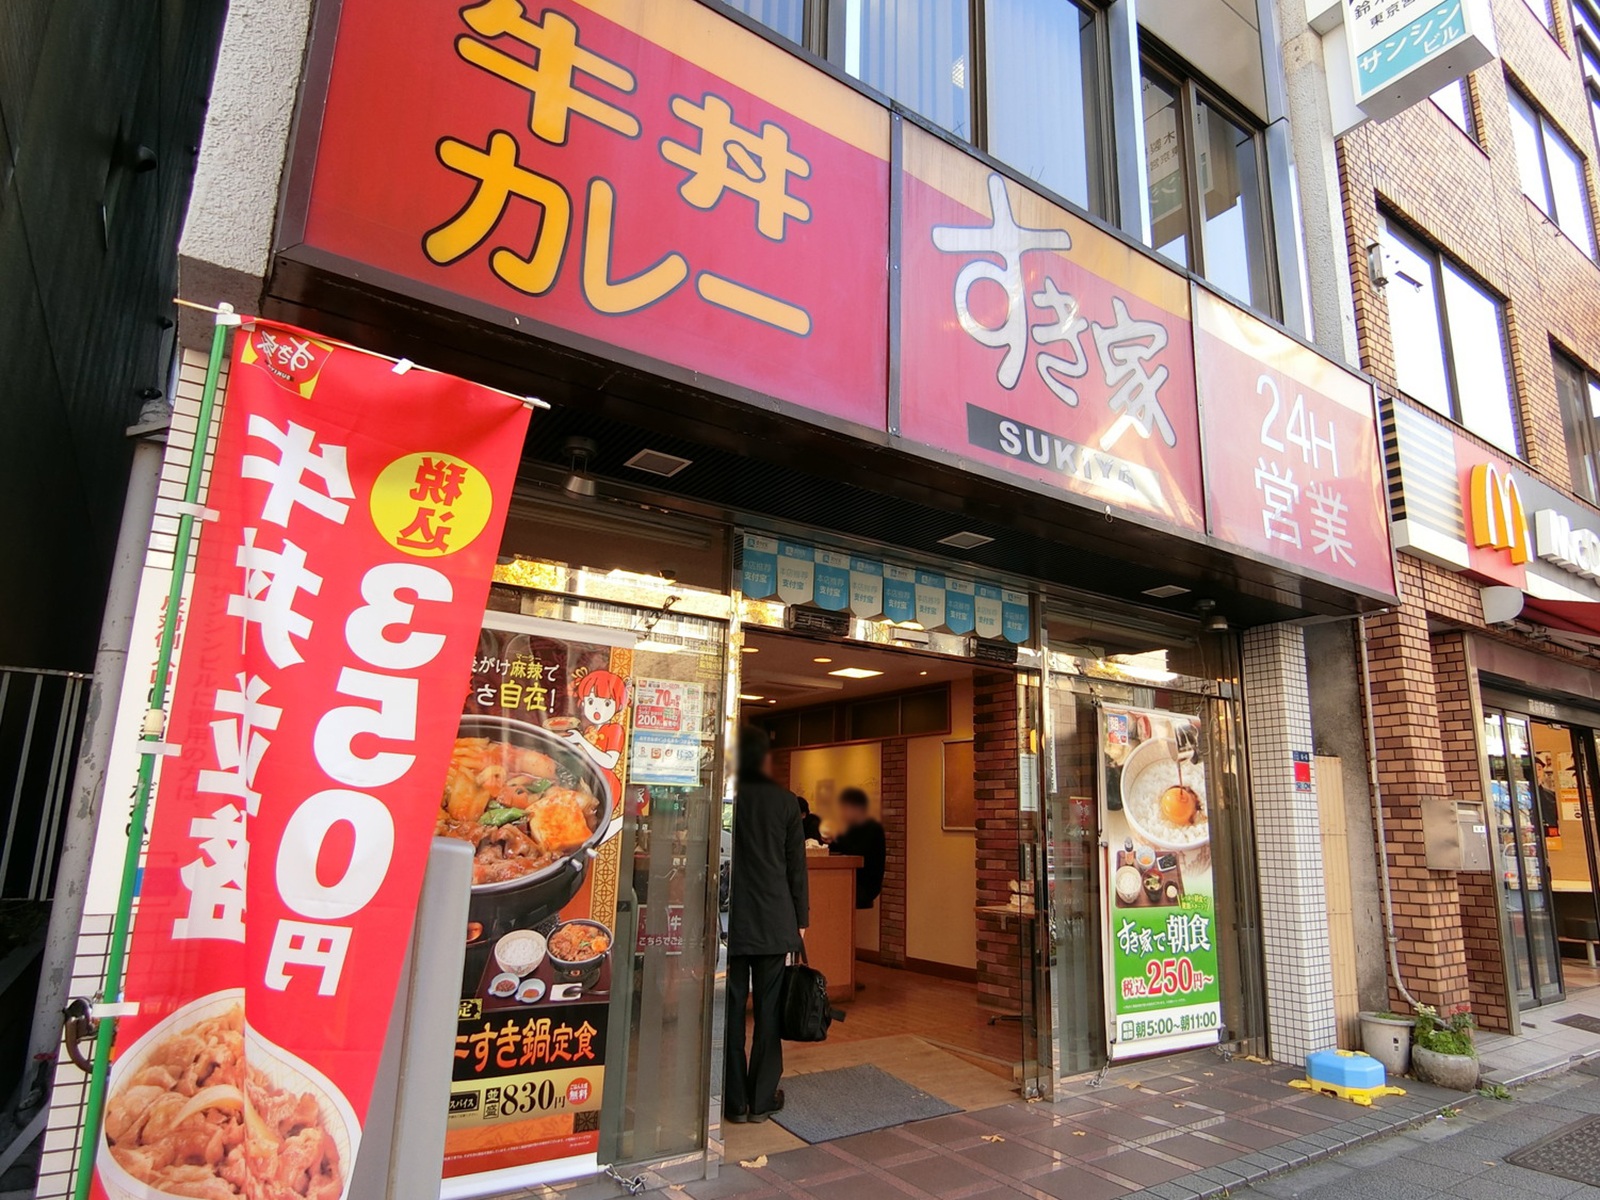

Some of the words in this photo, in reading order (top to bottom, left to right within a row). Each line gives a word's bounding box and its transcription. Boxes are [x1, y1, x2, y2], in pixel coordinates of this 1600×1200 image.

[1360, 2, 1460, 73] サンシン
[1423, 26, 1460, 54] ビル
[454, 0, 812, 241] 牛丼
[422, 130, 812, 336] カレー
[931, 172, 1177, 450] すき家
[1255, 375, 1341, 478] 24H
[1254, 457, 1357, 568] 営業
[744, 572, 768, 583] 支付宝
[782, 579, 804, 590] 支付宝
[819, 586, 841, 597] 支付宝
[1116, 913, 1212, 958] すき家で朝食
[486, 1089, 499, 1118] 並盛
[500, 1078, 566, 1116] 830円
[569, 1090, 588, 1101] 無料
